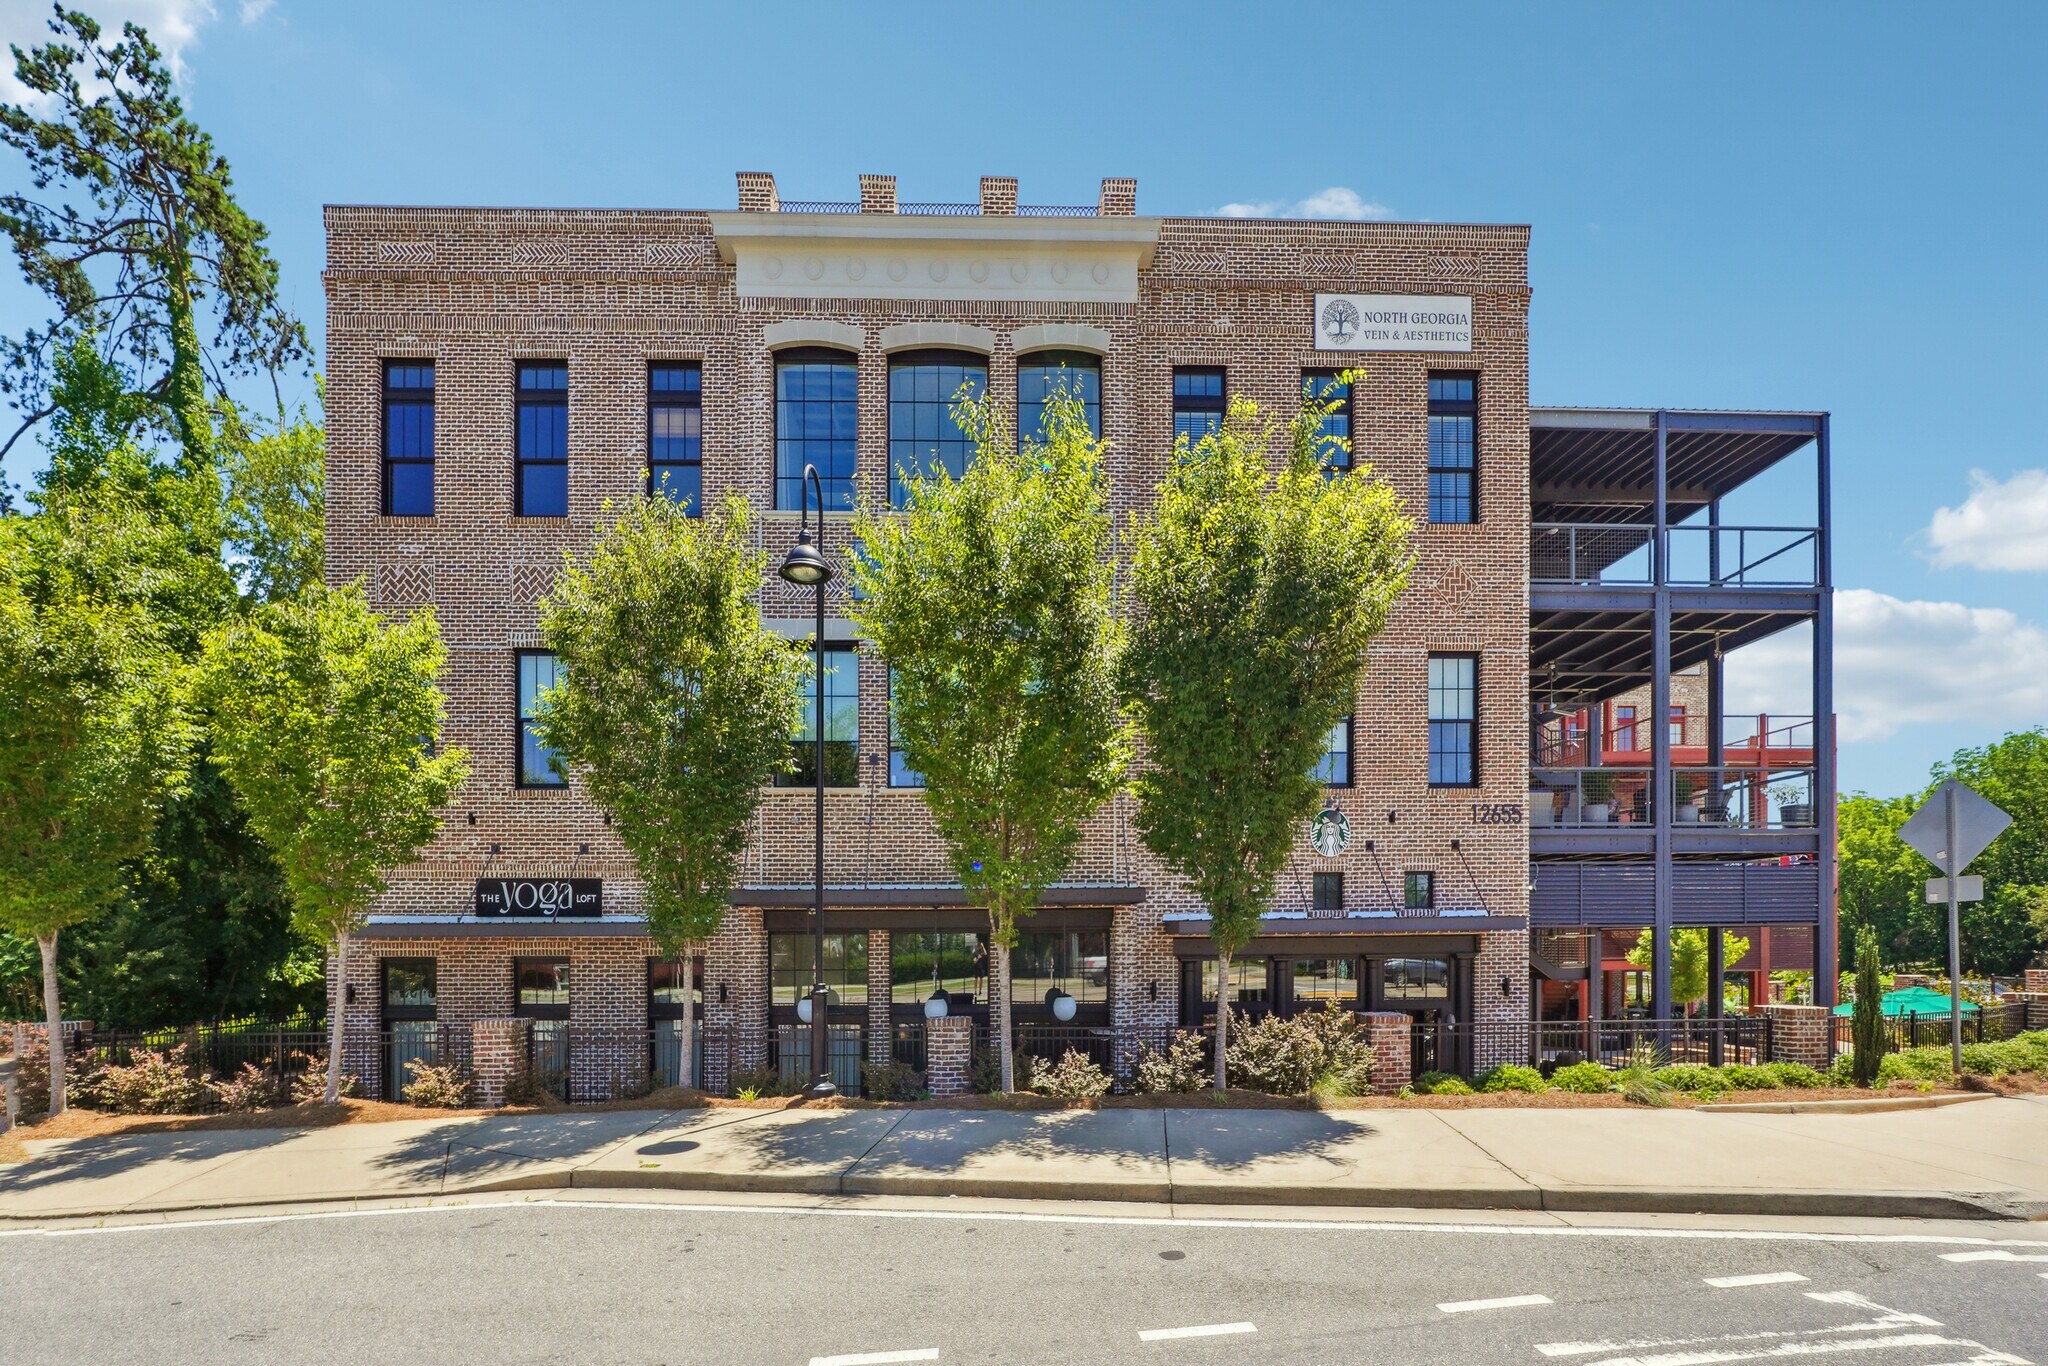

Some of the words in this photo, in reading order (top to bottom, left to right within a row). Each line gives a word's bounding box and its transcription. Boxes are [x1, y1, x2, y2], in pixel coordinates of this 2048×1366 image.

[1364, 311, 1408, 324] NORTH
[1411, 312, 1468, 325] GEORGIA
[1364, 330, 1391, 340] VEIN
[1392, 330, 1400, 340] &
[1403, 331, 1469, 342] AESTHETICS
[1471, 803, 1524, 825] 12655
[481, 894, 500, 903] THE
[499, 881, 573, 915] yoga
[576, 894, 597, 903] LOFT
